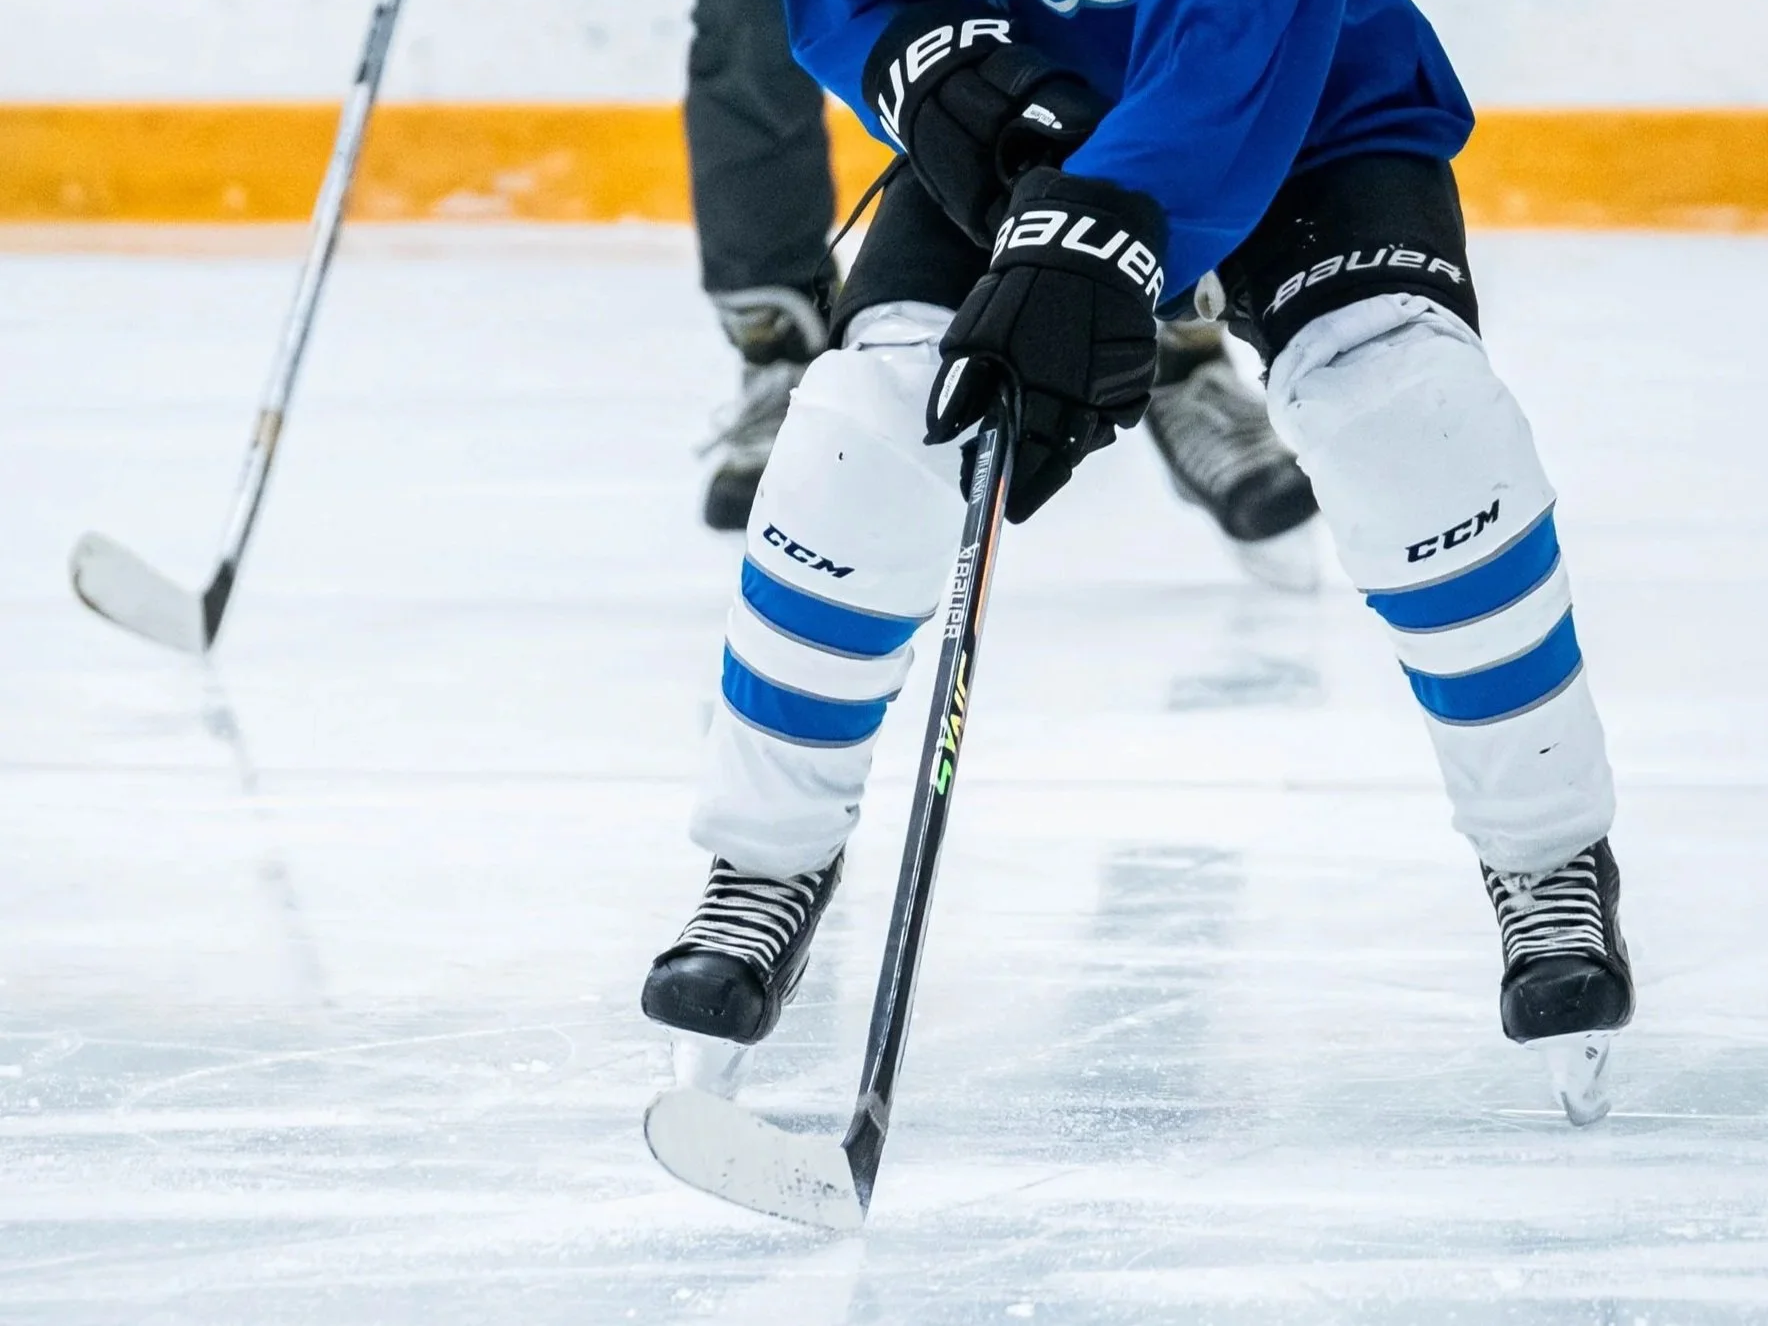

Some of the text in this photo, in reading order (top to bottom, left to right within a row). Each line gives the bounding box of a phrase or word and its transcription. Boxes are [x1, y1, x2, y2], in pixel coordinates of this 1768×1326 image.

[877, 18, 1012, 155] UER
[762, 522, 856, 579] CCM
[1405, 498, 1500, 563] CCM
[943, 562, 972, 640] BAUER
